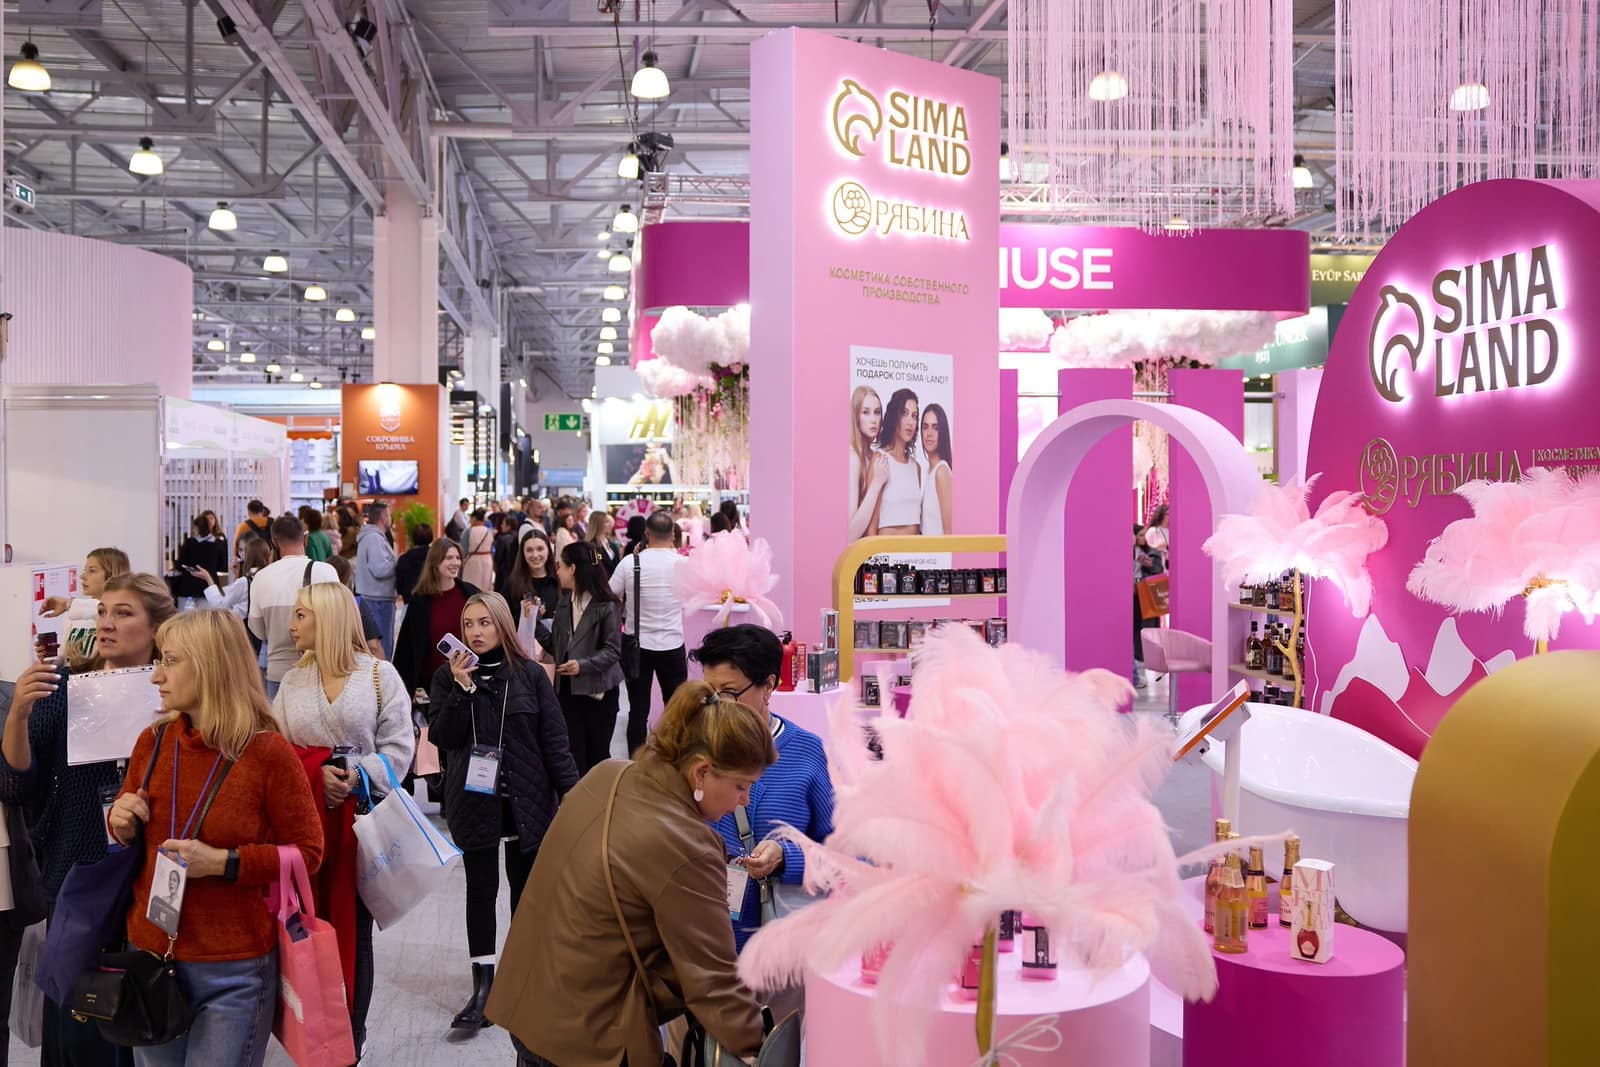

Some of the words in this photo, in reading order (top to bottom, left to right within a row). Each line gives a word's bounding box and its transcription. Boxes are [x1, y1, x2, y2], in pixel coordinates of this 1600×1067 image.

[888, 91, 969, 141] SIMA
[889, 129, 971, 176] LAND
[876, 200, 971, 240] РЯБИНА
[829, 266, 891, 285] КОСМЕТИКА
[893, 274, 970, 296] СОБСТВЕННОГО
[1000, 247, 1114, 289] USE
[862, 285, 941, 305] ПРОИЗВОДСТВА
[1432, 245, 1558, 334] SIMA
[856, 357, 888, 368] ХОЧЕШЬ
[889, 360, 928, 372] ПОЛУЧИТЬ
[857, 369, 895, 380] ПОДАРОК
[896, 372, 905, 381] ОТ
[1435, 318, 1559, 397] LAND
